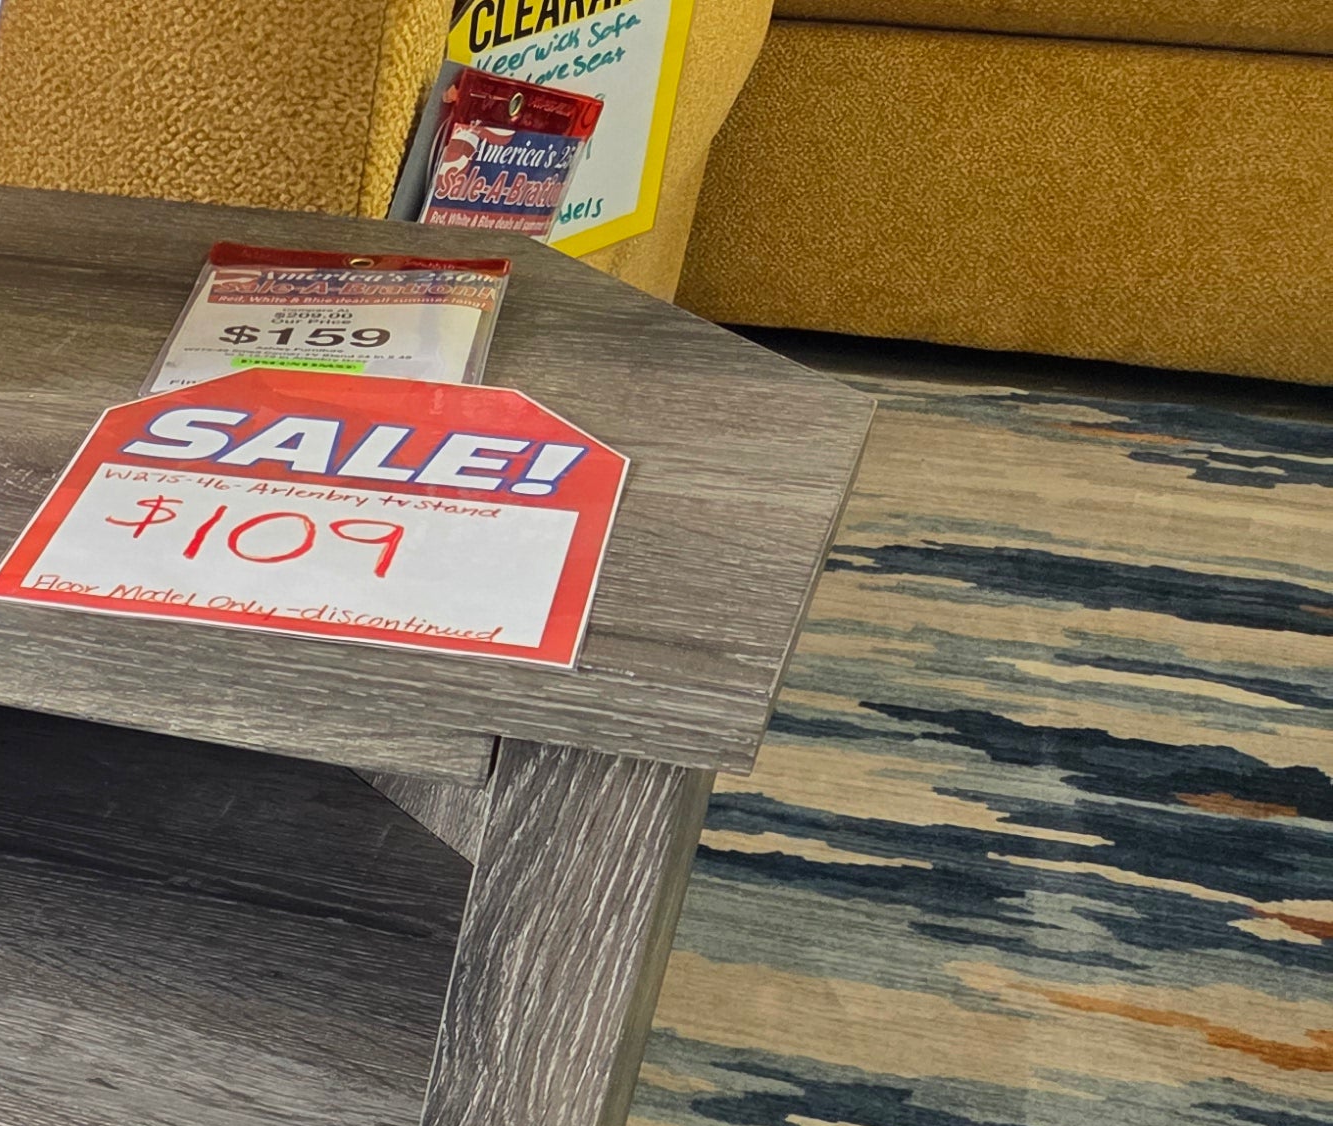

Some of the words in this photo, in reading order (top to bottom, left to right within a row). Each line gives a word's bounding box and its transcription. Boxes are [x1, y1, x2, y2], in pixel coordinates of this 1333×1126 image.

[588, 12, 641, 48] Sofa
[470, 138, 558, 169] America's
[447, 212, 471, 227] White
[477, 215, 495, 229] Blue
[263, 270, 408, 283] America's
[249, 296, 288, 304] White
[303, 296, 332, 304] Blue
[274, 312, 353, 320] $209.00
[218, 325, 391, 347] $159
[121, 408, 587, 496] SALE!
[104, 494, 405, 579] $109
[33, 574, 100, 593] Floor
[107, 584, 197, 606] Model
[207, 595, 278, 621] Only
